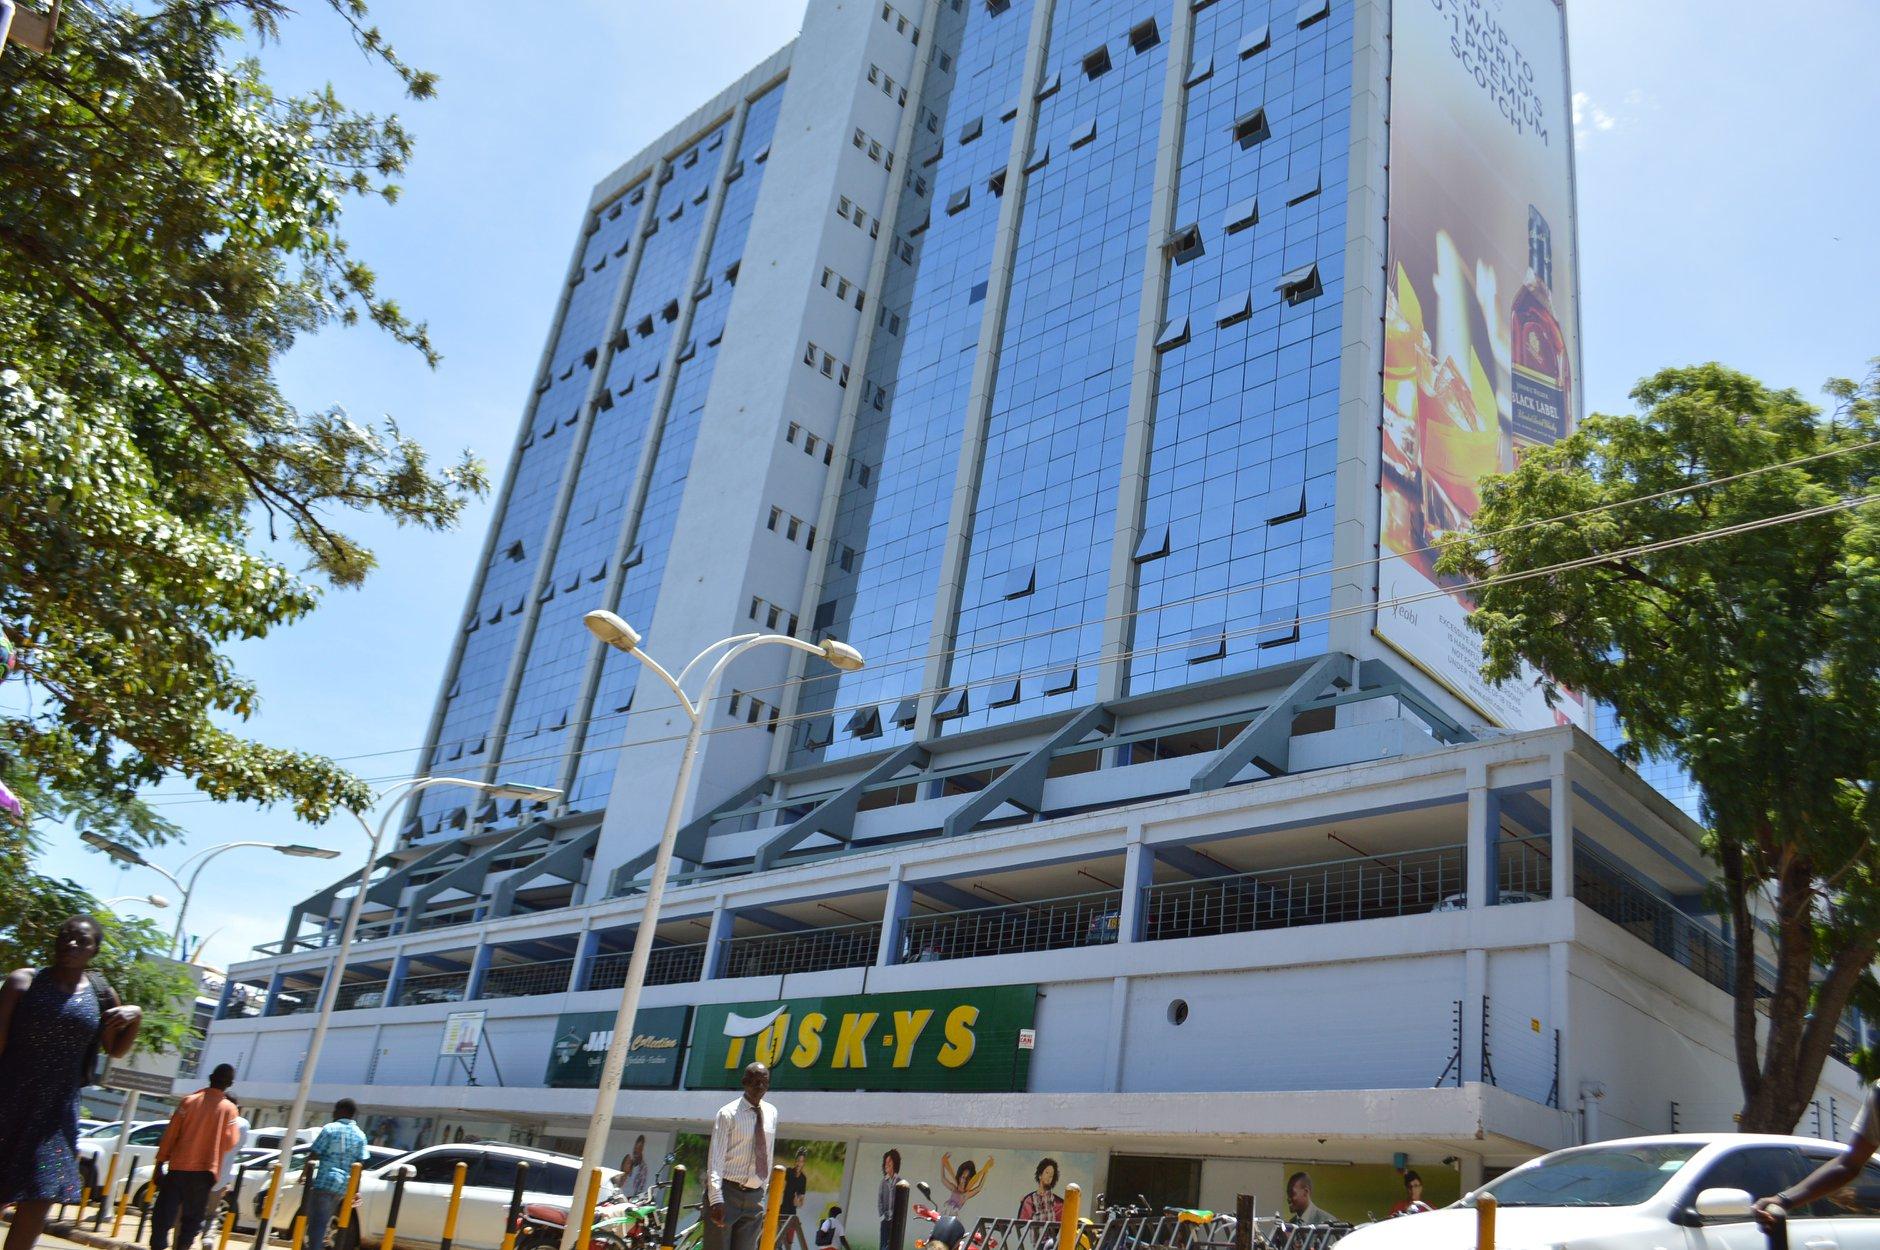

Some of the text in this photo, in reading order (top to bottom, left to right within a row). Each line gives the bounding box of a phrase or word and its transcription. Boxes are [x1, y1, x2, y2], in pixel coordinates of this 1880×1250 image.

[1450, 35, 1521, 135] SCOTCH
[1463, 4, 1543, 118] WORLD'S
[1465, 28, 1548, 147] PREMIUM
[1485, 8, 1534, 82] UP TO
[1535, 400, 1560, 419] LABEL
